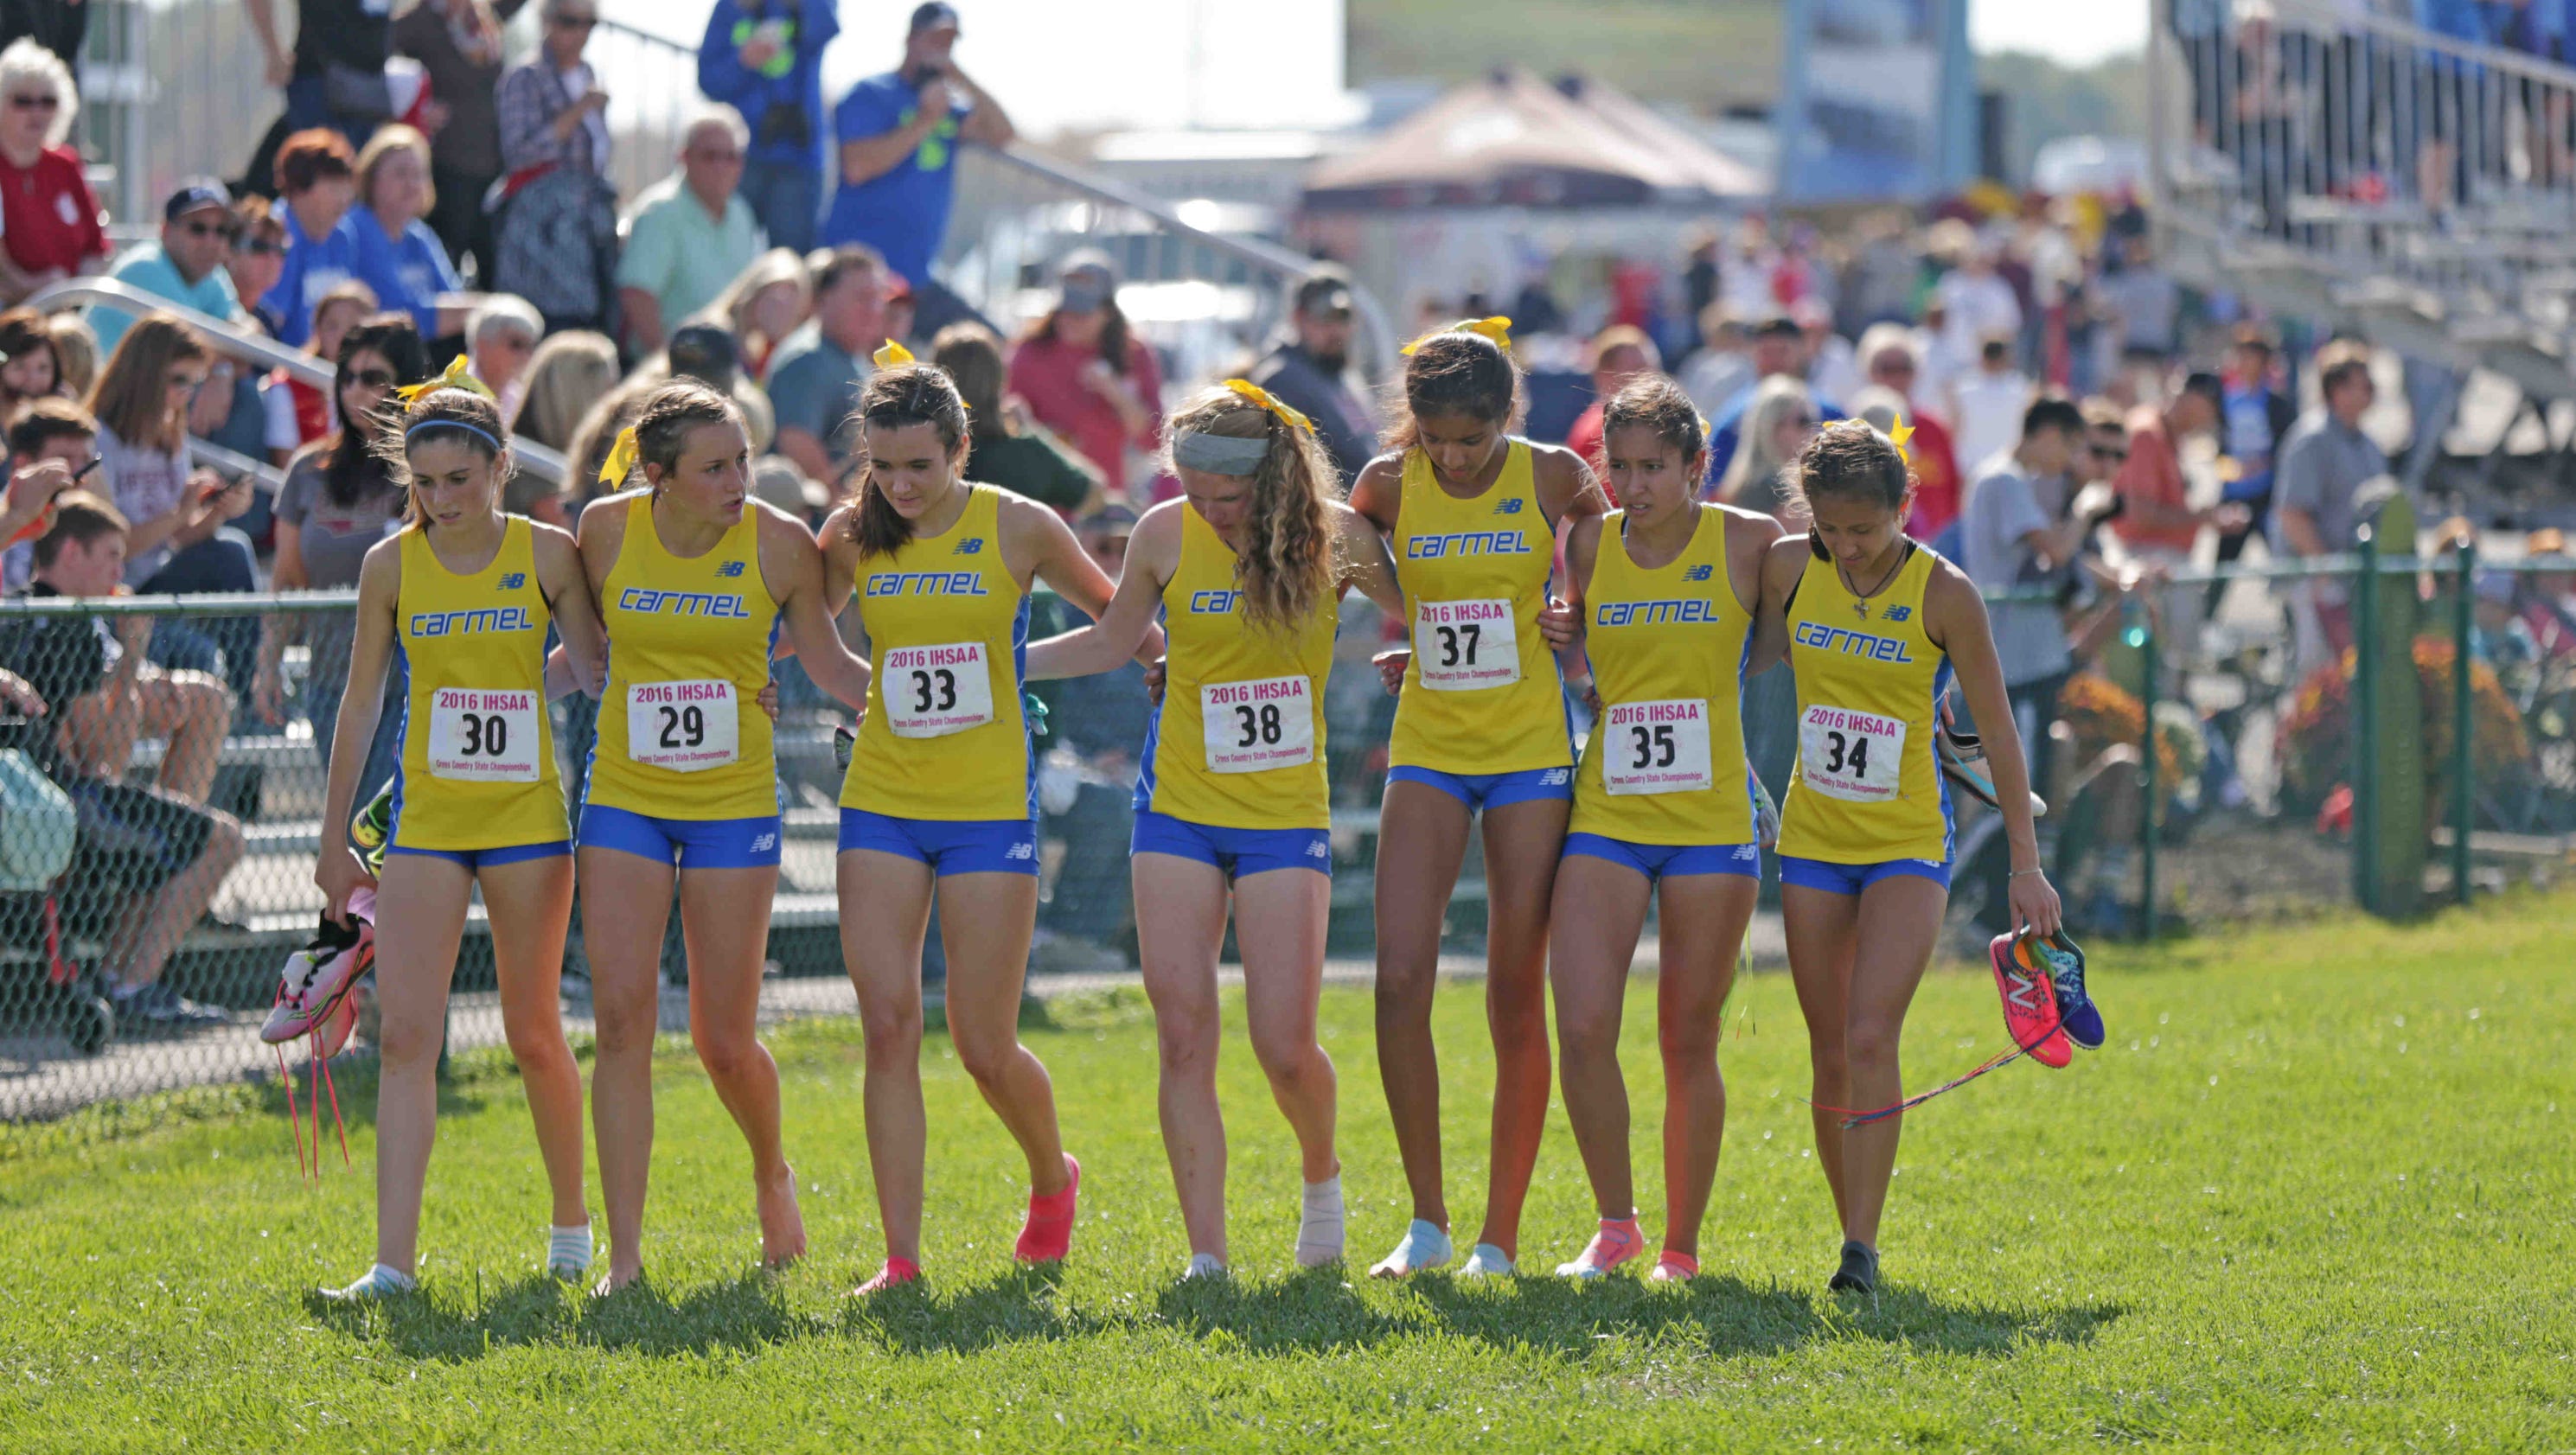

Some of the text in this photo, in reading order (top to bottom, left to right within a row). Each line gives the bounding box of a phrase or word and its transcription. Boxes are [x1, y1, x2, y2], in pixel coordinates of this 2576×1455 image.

[1454, 603, 1504, 621] IHSAA
[1436, 624, 1480, 667] 37
[891, 647, 978, 668] 2016 IHSAA
[1436, 671, 1454, 681] Country
[1456, 671, 1469, 680] State
[1471, 668, 1512, 679] Championships
[636, 684, 726, 703] 2016 IHSAA
[911, 669, 956, 713] 33
[1210, 680, 1302, 704] 2016 IHSAA
[439, 692, 529, 711] 2016 IHSAA
[908, 718, 927, 729] Country
[929, 717, 943, 726] State
[944, 713, 985, 724] Championships
[1612, 704, 1699, 724] 2016 IHSAA
[1808, 709, 1895, 737] 2016 IHSAA
[461, 713, 507, 756] 30
[659, 705, 704, 749] 29
[1235, 704, 1281, 748] 38
[654, 754, 673, 763] Country
[691, 749, 730, 761] Championships
[1230, 754, 1251, 763] Country
[1253, 751, 1267, 760] State
[1269, 747, 1307, 758] Championships
[1631, 724, 1675, 769] 35
[1826, 731, 1868, 778] 34
[452, 760, 473, 771] Country
[475, 761, 489, 770] State
[490, 762, 531, 772] Championships
[1626, 775, 1645, 785] Country
[1646, 773, 1660, 782] State
[1662, 771, 1703, 782] Championships
[1819, 775, 1834, 788] Country
[1836, 779, 1849, 789] State
[1851, 781, 1889, 794] Championships
